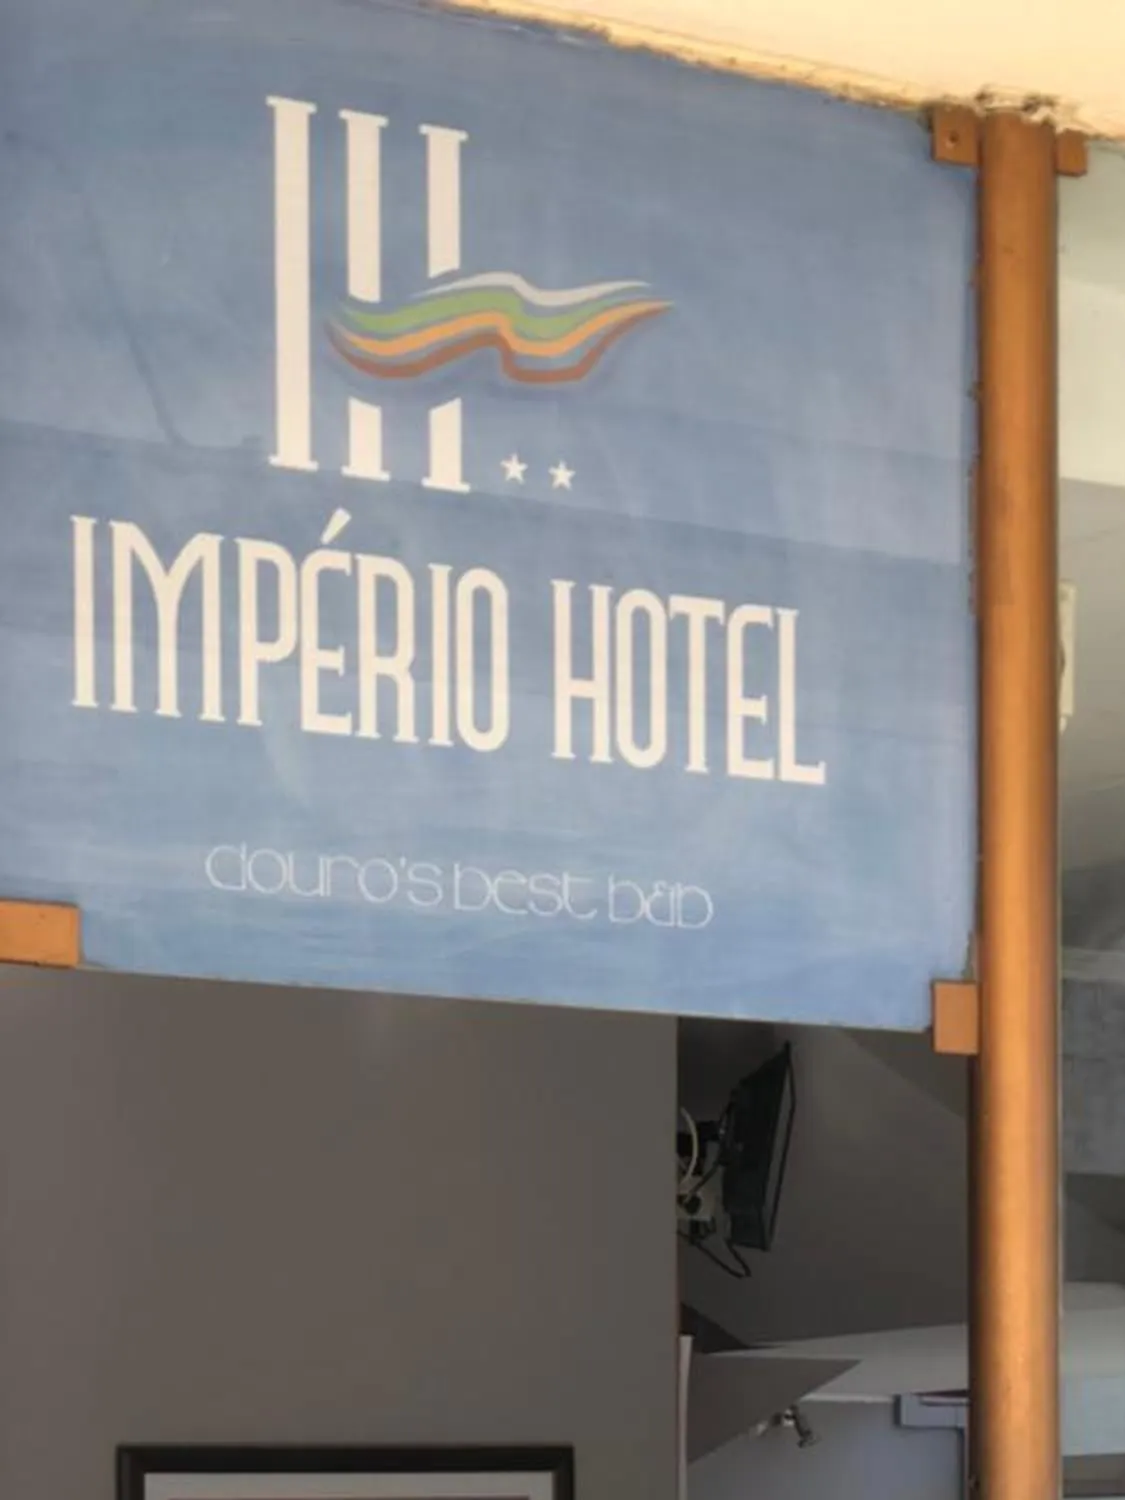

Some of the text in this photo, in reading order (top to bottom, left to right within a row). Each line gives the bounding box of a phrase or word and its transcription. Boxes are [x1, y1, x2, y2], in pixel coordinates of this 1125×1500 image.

[70, 508, 827, 786] IMPÉRIO HOTEL
[204, 839, 444, 908] douro's
[453, 861, 596, 921] best
